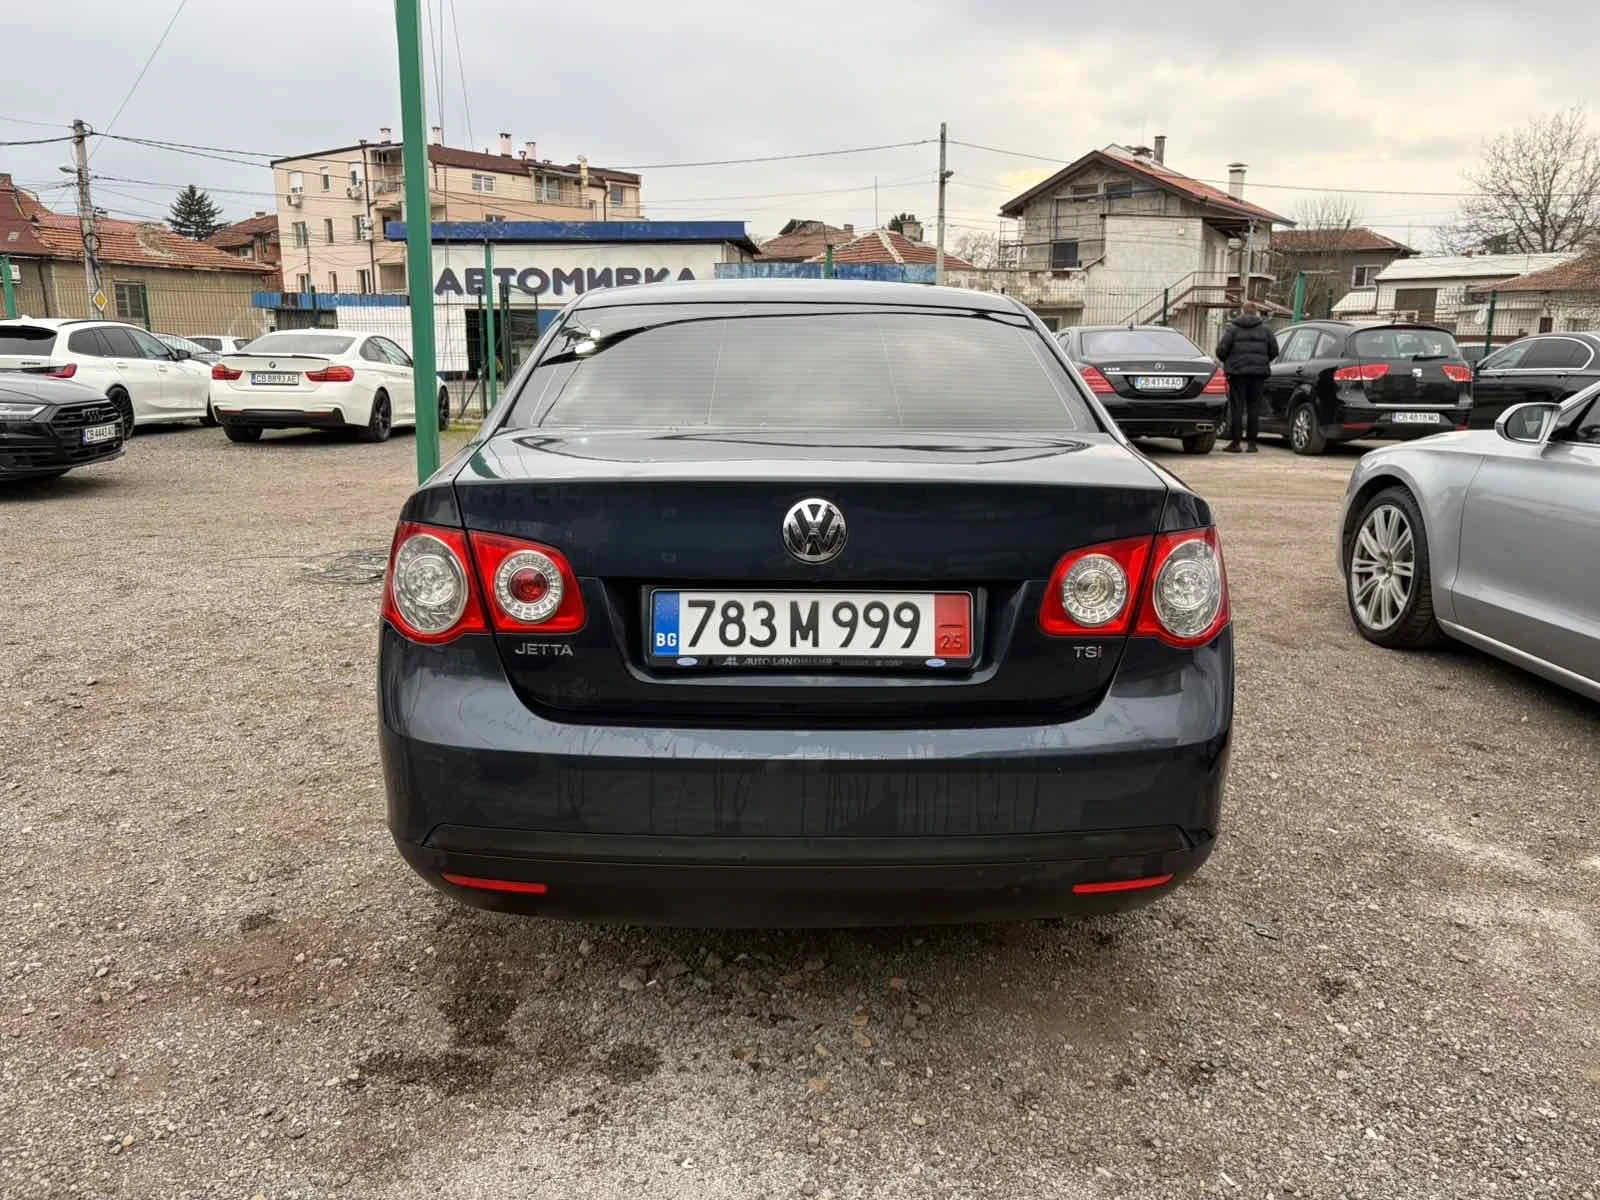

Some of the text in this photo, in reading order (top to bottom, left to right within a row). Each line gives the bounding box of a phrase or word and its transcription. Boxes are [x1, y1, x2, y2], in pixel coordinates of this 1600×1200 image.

[687, 600, 921, 648] 783 M 999
[656, 633, 676, 646] BG
[942, 635, 961, 649] 25
[515, 642, 574, 656] JETTA
